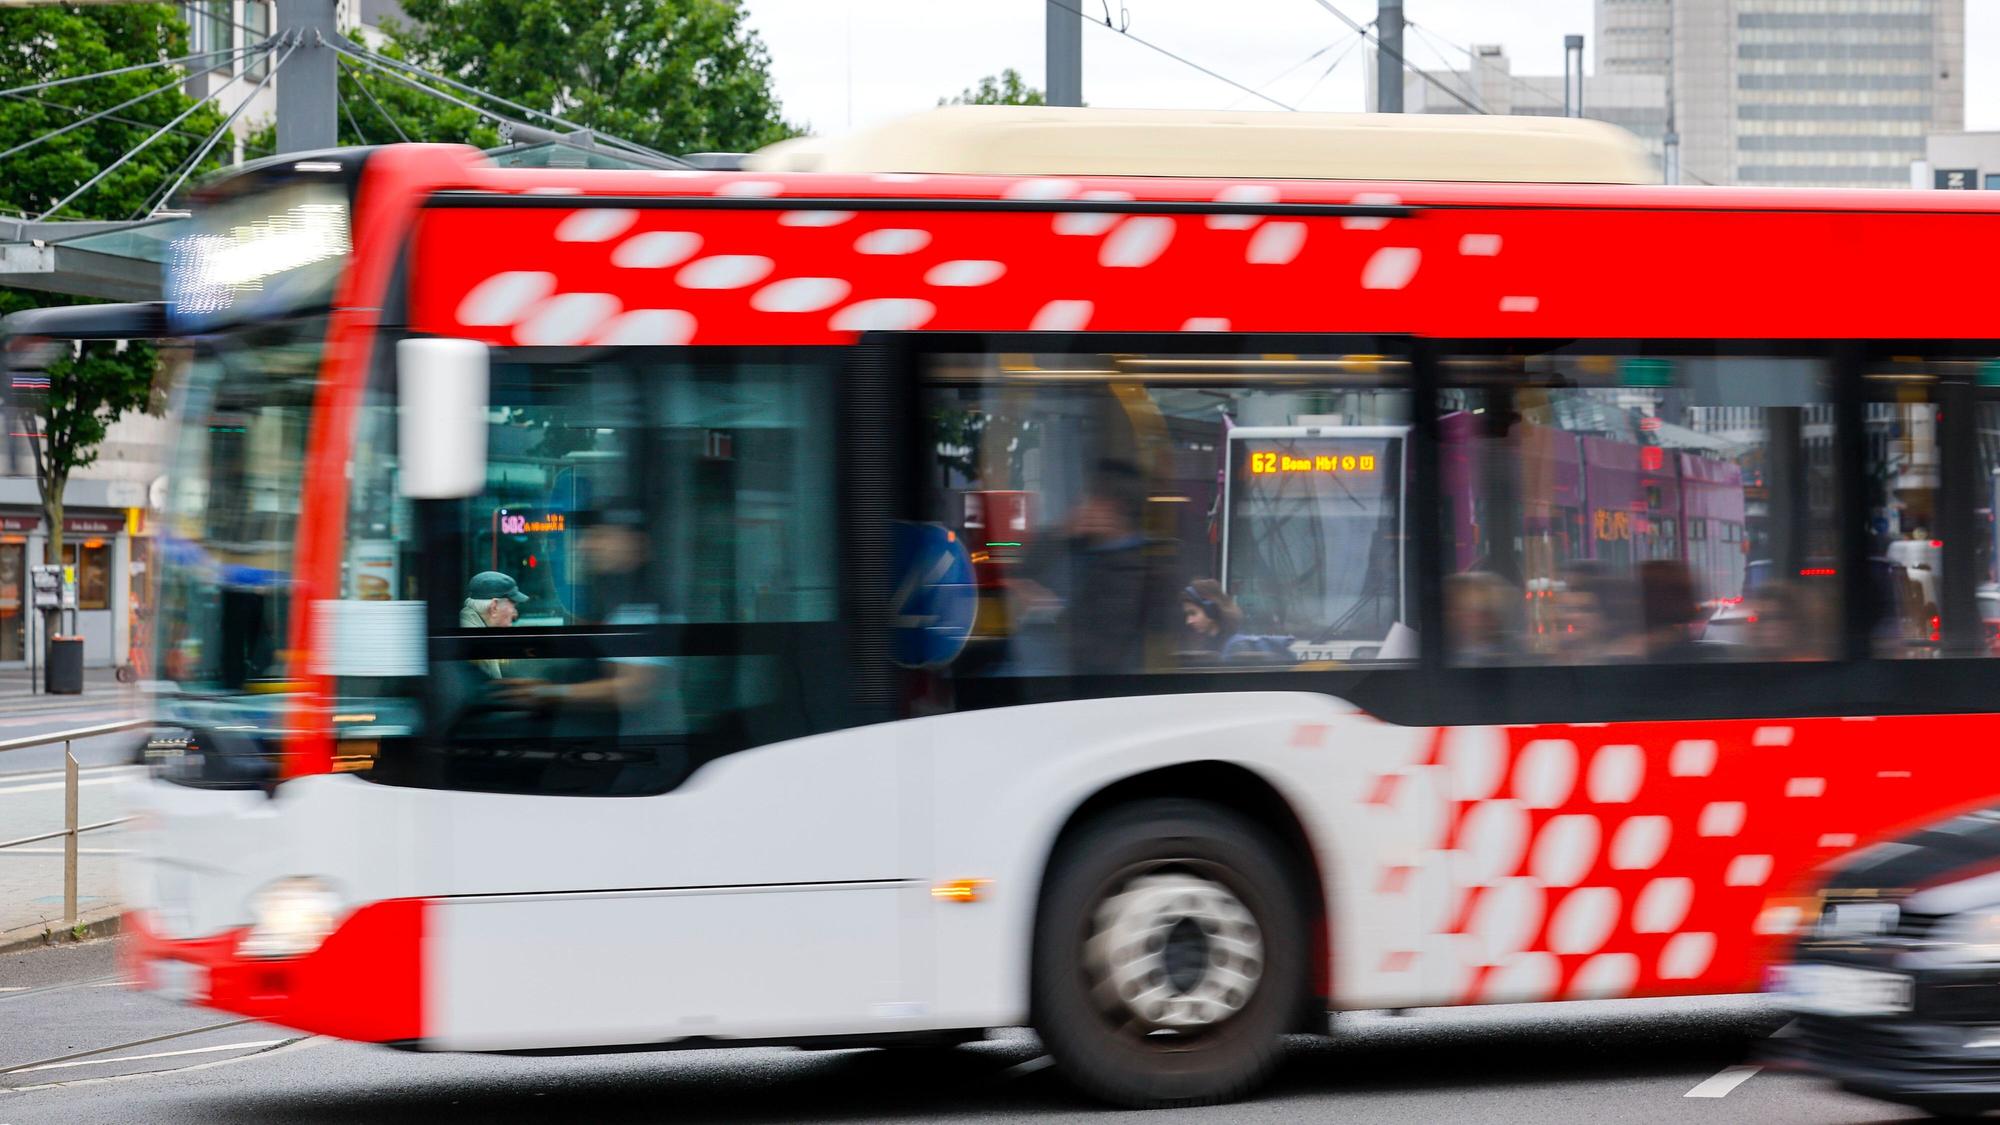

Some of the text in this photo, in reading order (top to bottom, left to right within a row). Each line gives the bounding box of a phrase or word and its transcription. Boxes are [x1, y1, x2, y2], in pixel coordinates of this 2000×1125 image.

[1252, 453, 1276, 473] 62
[1281, 456, 1312, 471] Bonn
[1315, 456, 1338, 471] Hbf
